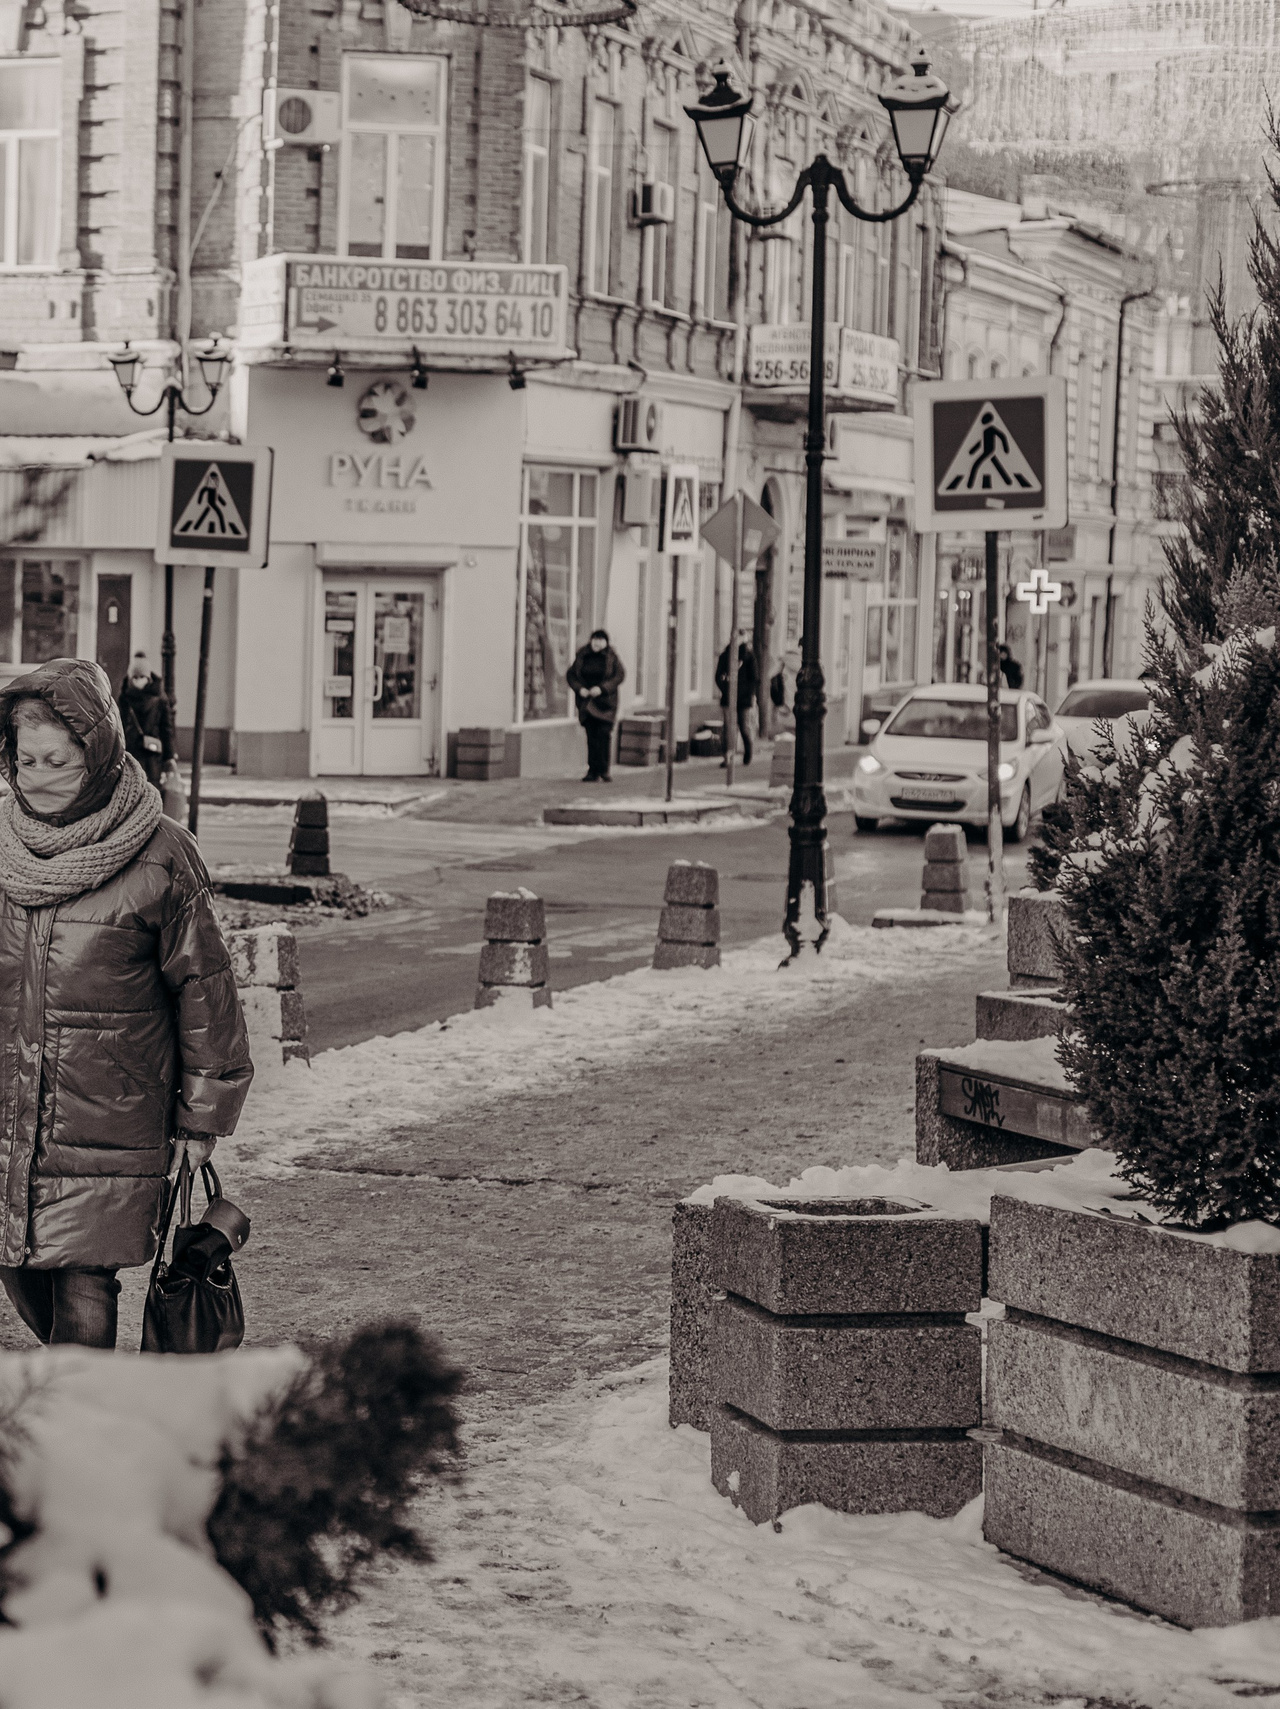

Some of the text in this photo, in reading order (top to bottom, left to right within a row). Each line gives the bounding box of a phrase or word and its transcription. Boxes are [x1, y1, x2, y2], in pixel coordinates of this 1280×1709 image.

[296, 264, 556, 296] БАНКРОТСТВО ФИЗ. ЛИЦ
[375, 295, 554, 338] 8 863 303 64 10
[327, 454, 436, 489] РУНА
[823, 547, 876, 557] ВЕЛИРНАЯ
[825, 560, 874, 568] АСТЕРСКАЯ
